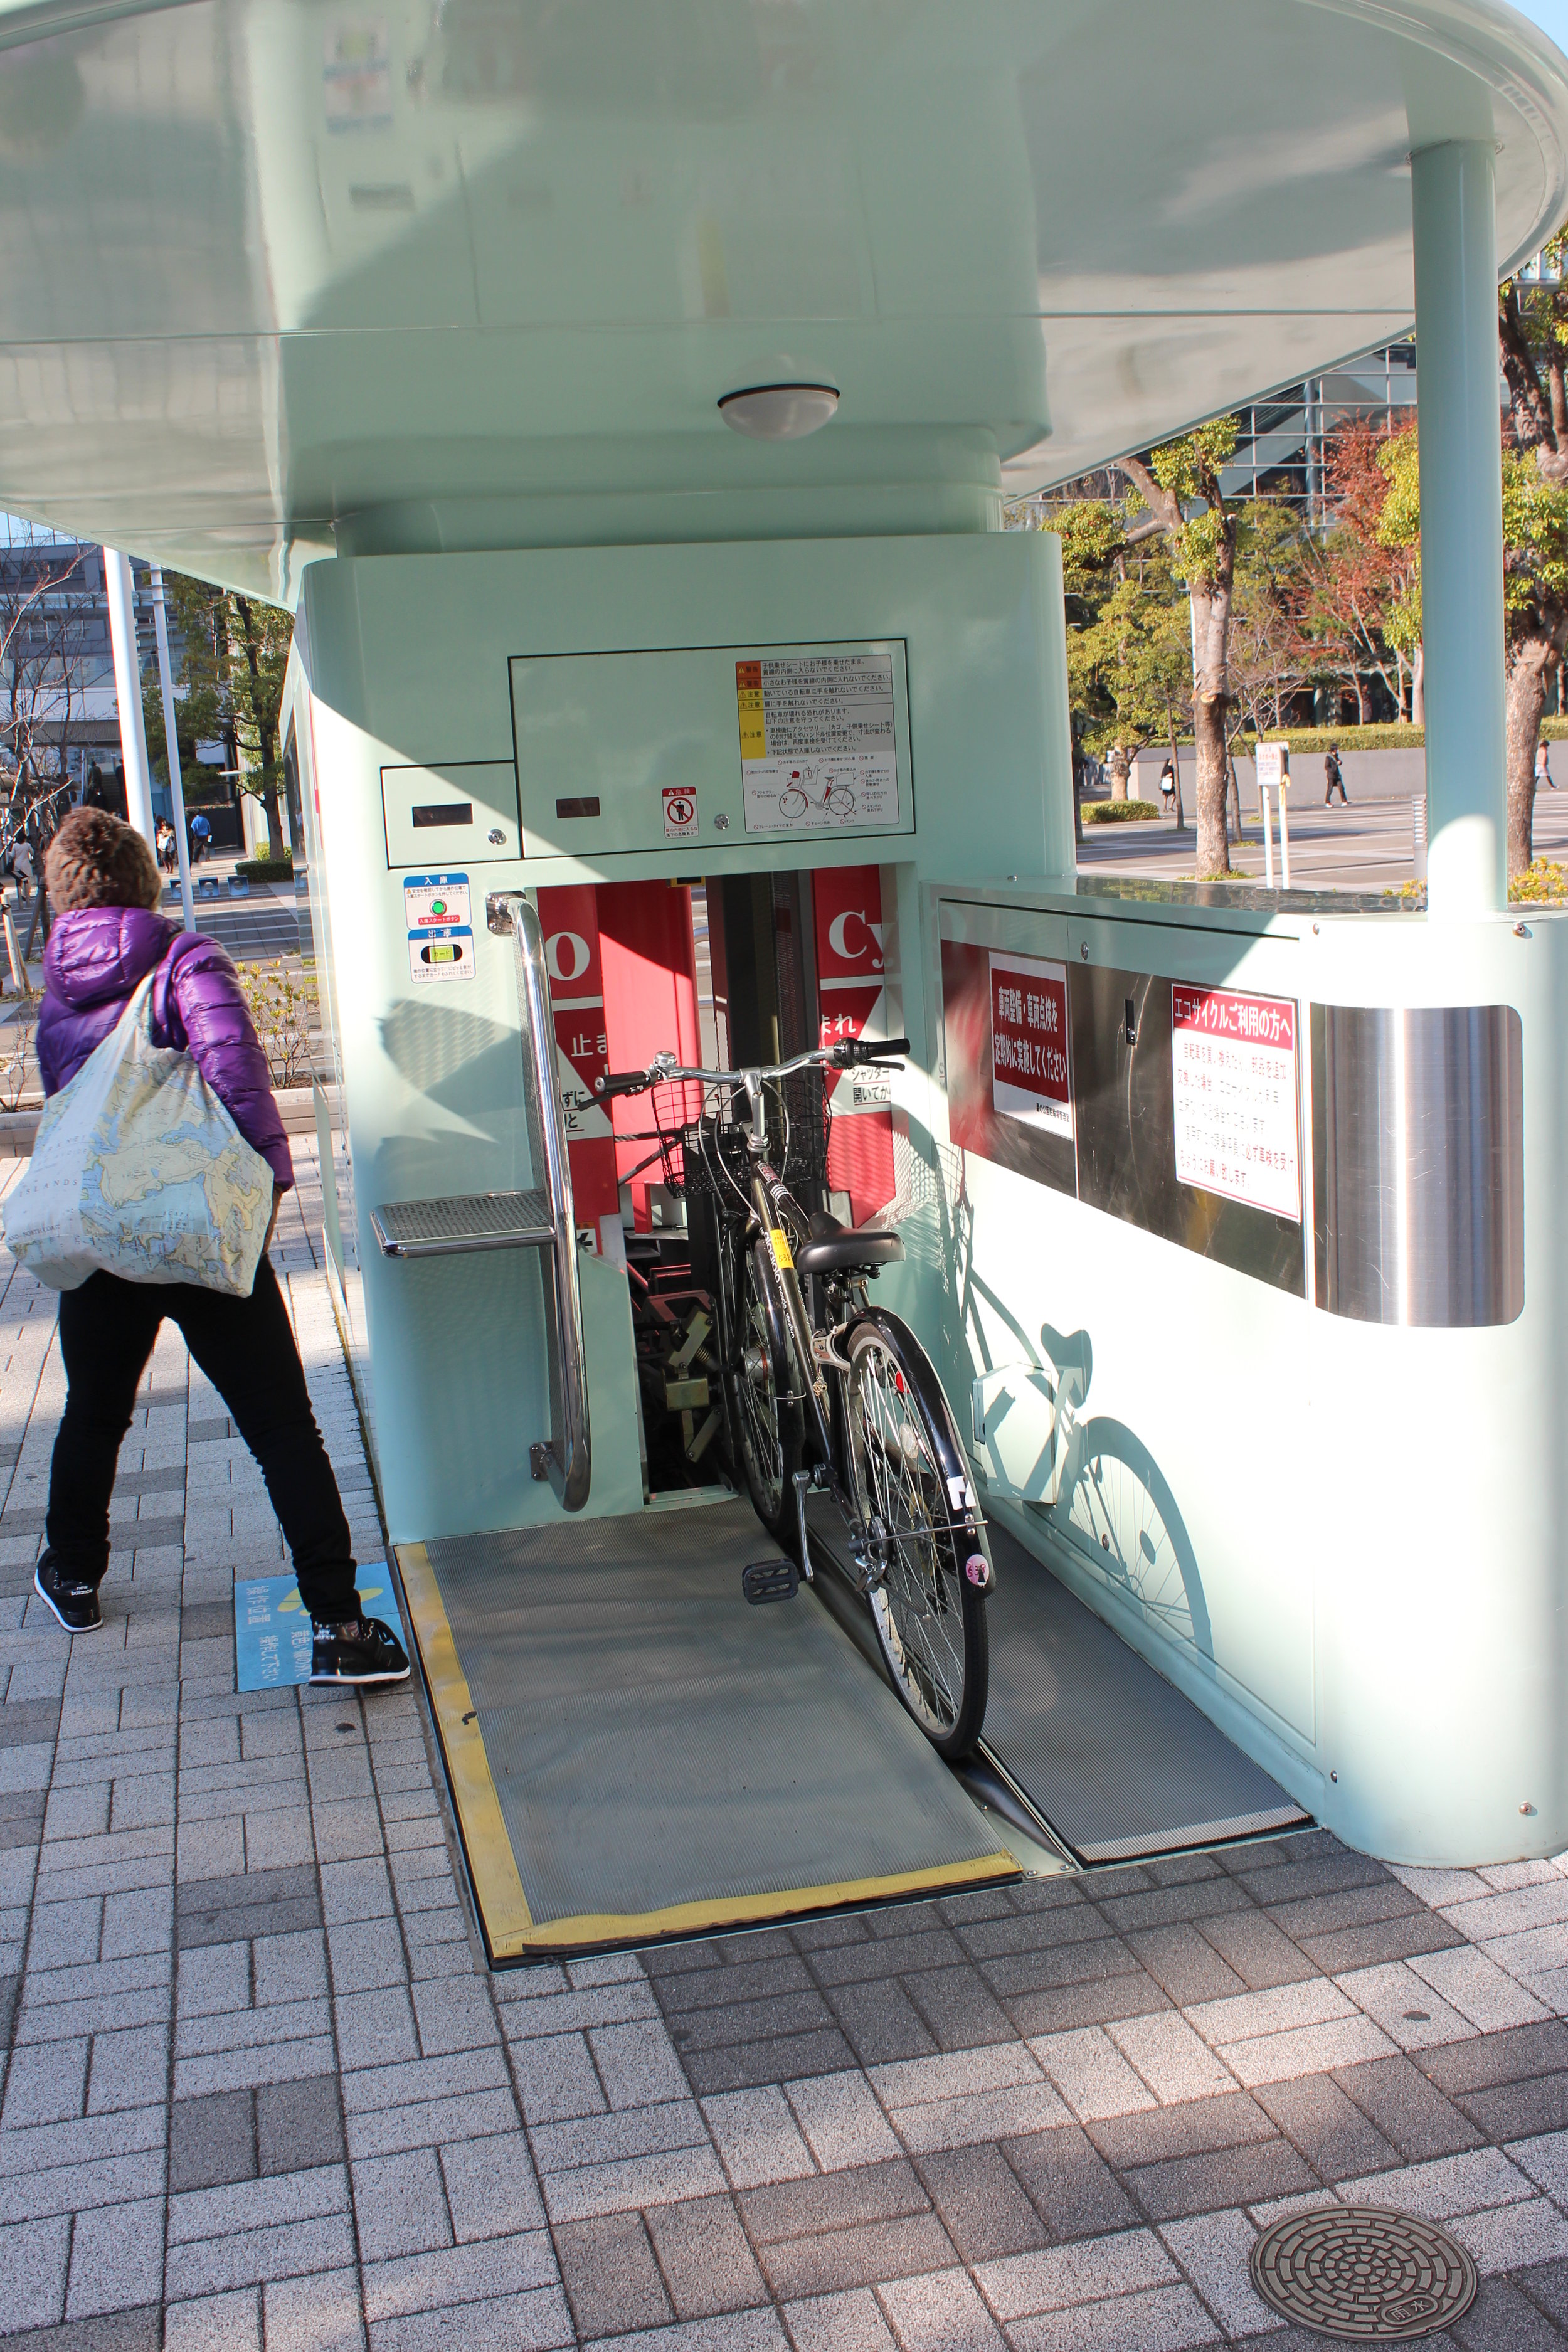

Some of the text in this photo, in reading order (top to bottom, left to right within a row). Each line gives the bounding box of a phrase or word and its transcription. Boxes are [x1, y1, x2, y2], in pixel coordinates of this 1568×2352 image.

[999, 986, 1058, 1032] 車両整備・車両点検を
[1175, 997, 1292, 1041] エコサイクルご利用の方へ
[994, 1031, 1067, 1083] 定期的に実施してください
[19, 1179, 78, 1198] ISLANDS
[246, 1586, 272, 1626] 操作位置
[259, 1635, 281, 1682] 操作して下さい
[1389, 2300, 1429, 2321] 雨水
